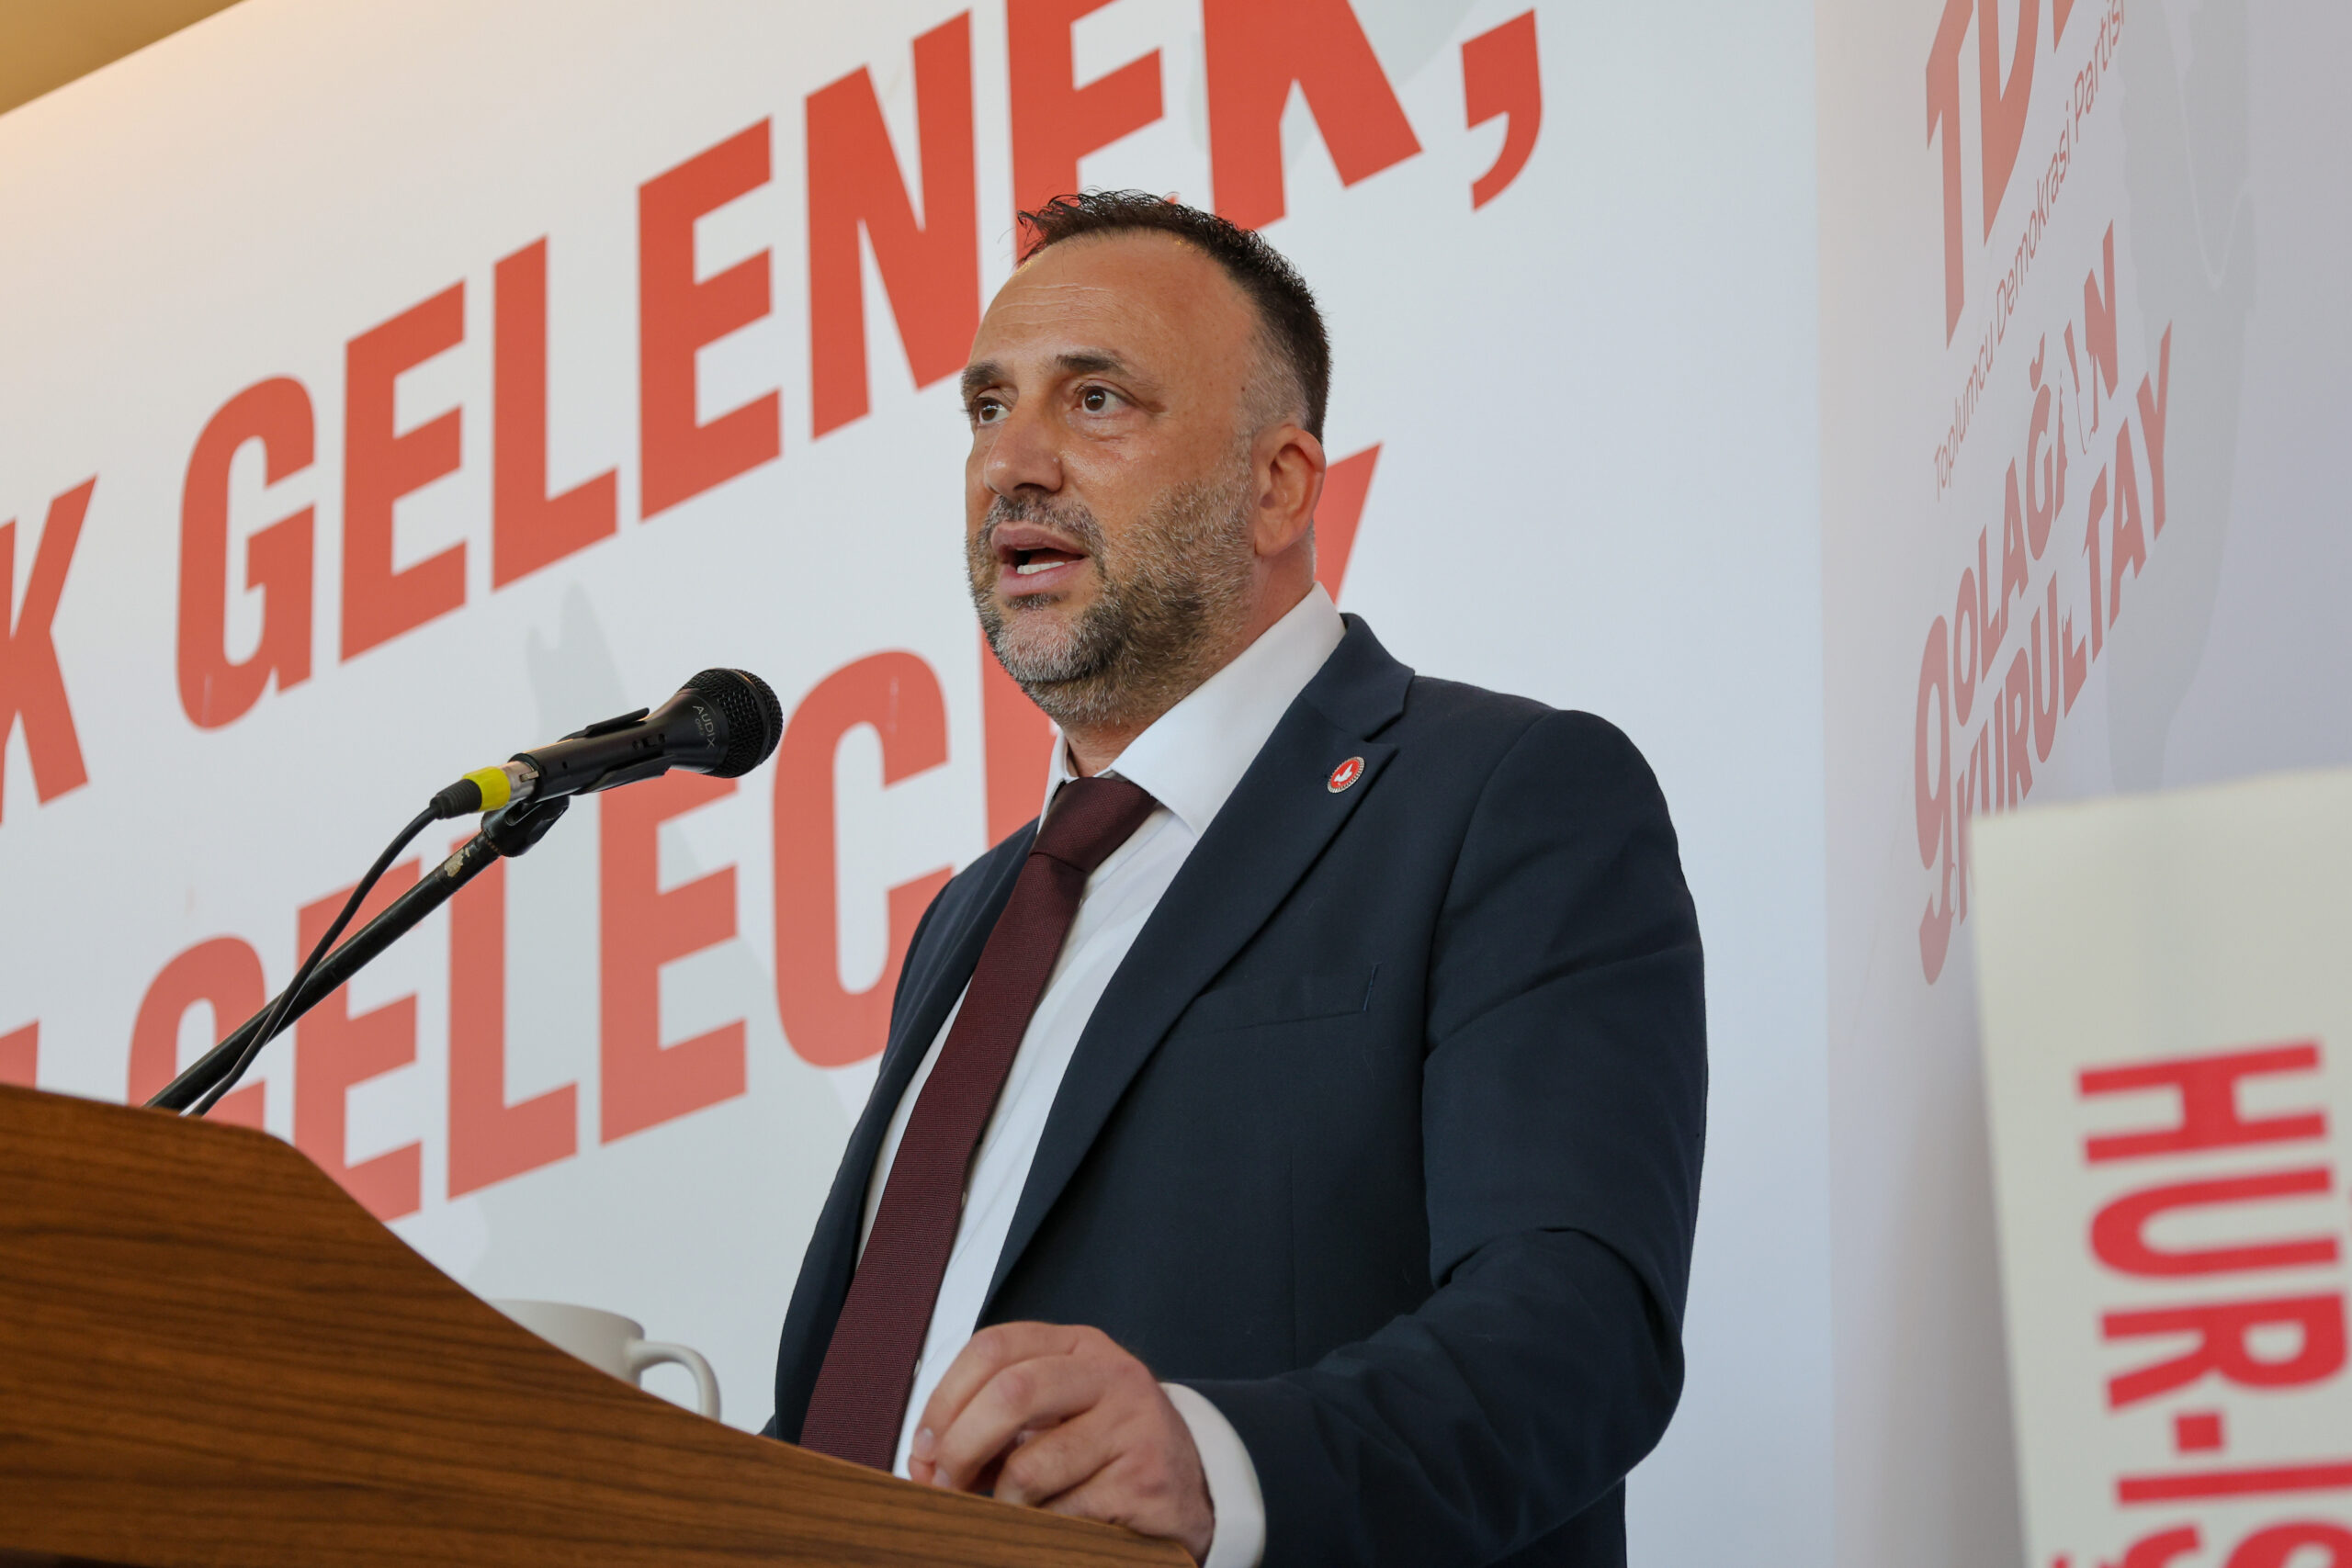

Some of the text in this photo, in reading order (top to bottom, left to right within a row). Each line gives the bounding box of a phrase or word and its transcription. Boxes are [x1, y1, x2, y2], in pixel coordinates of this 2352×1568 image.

[1926, 0, 2075, 350] TD
[1934, 321, 1994, 502] Toplumcu
[1996, 101, 2071, 347] Demokrasi
[693, 705, 715, 750] AUDIX
[1957, 319, 2172, 927] KURULTAY
[126, 442, 1383, 1226] GELEC
